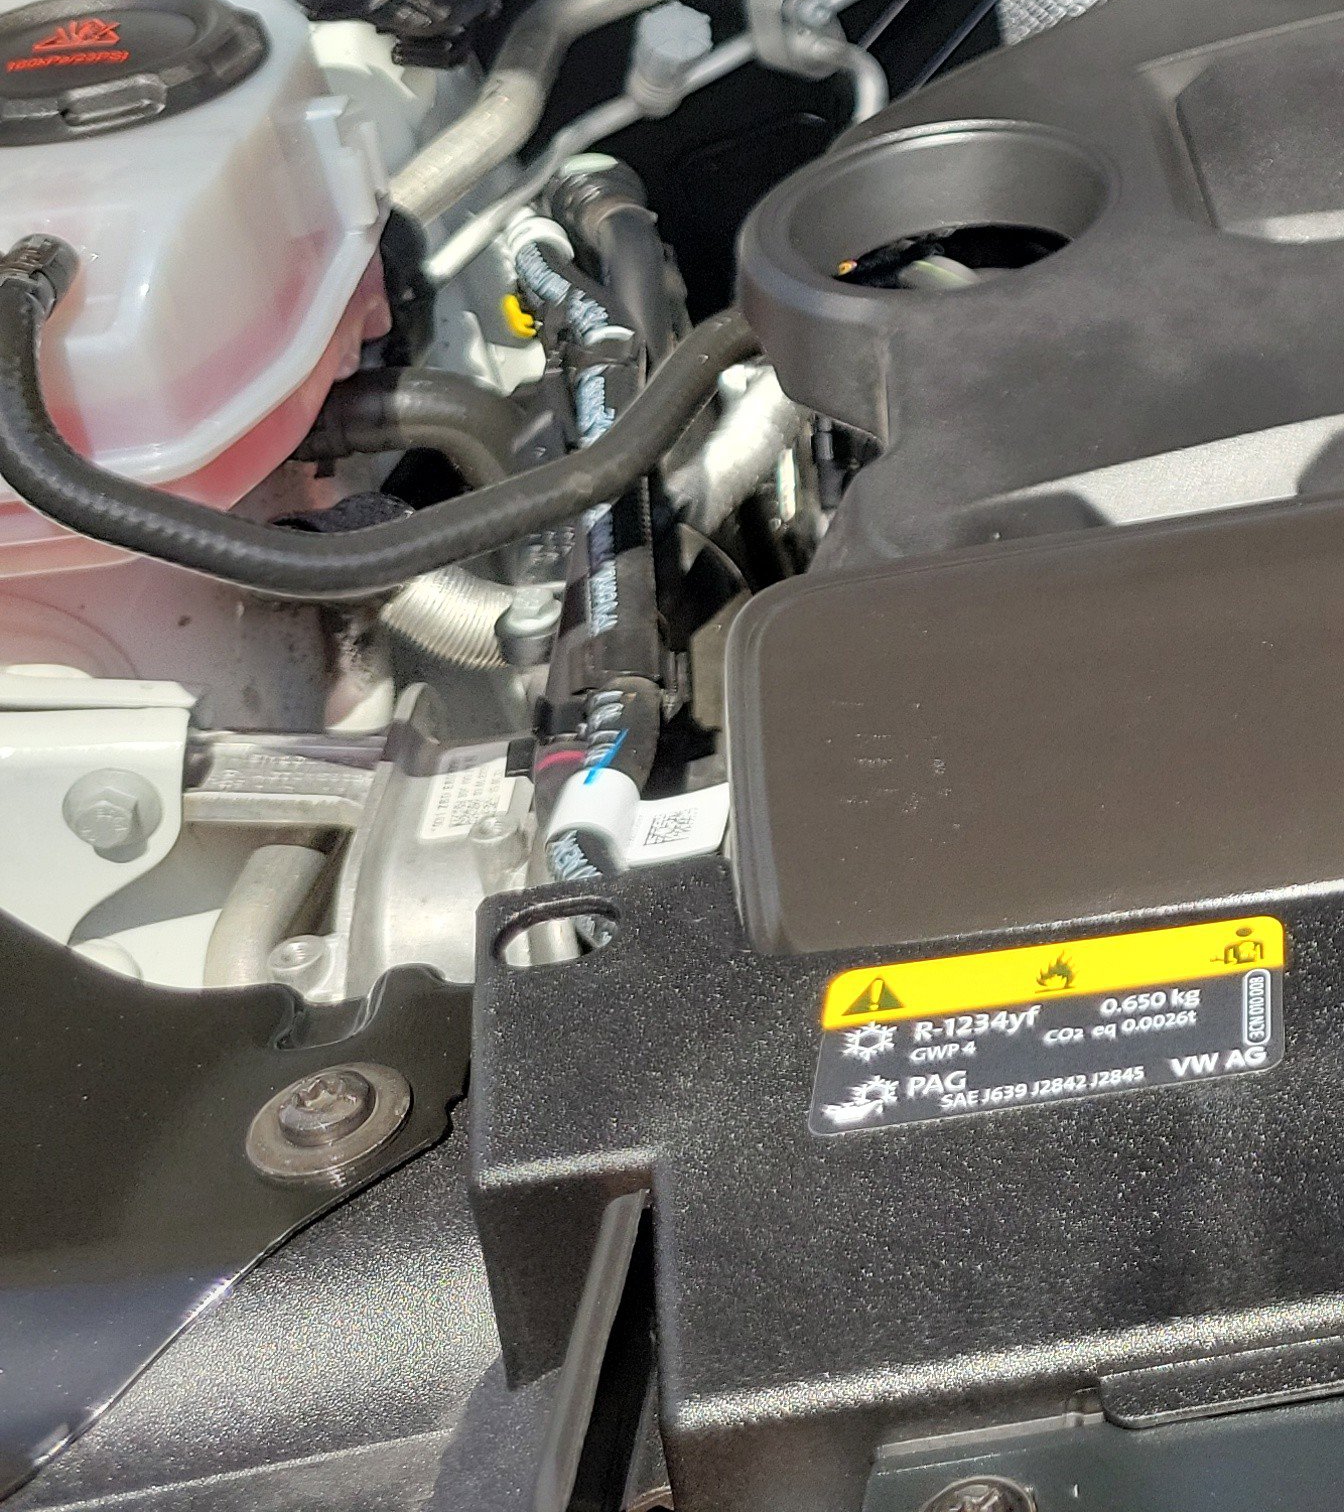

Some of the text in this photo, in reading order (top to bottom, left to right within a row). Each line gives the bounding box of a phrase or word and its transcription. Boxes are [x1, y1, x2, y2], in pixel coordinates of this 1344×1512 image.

[1099, 988, 1200, 1016] 0.650 kg
[913, 1004, 1040, 1041] R-1234yf
[1090, 1023, 1116, 1038] eq
[1120, 1010, 1196, 1032] 0.0026t
[908, 1040, 976, 1063] GWP 4
[1170, 1045, 1266, 1076] VW AG
[906, 1070, 966, 1097] PAG
[940, 1065, 1144, 1110] SAE J639 J2842 J2845
